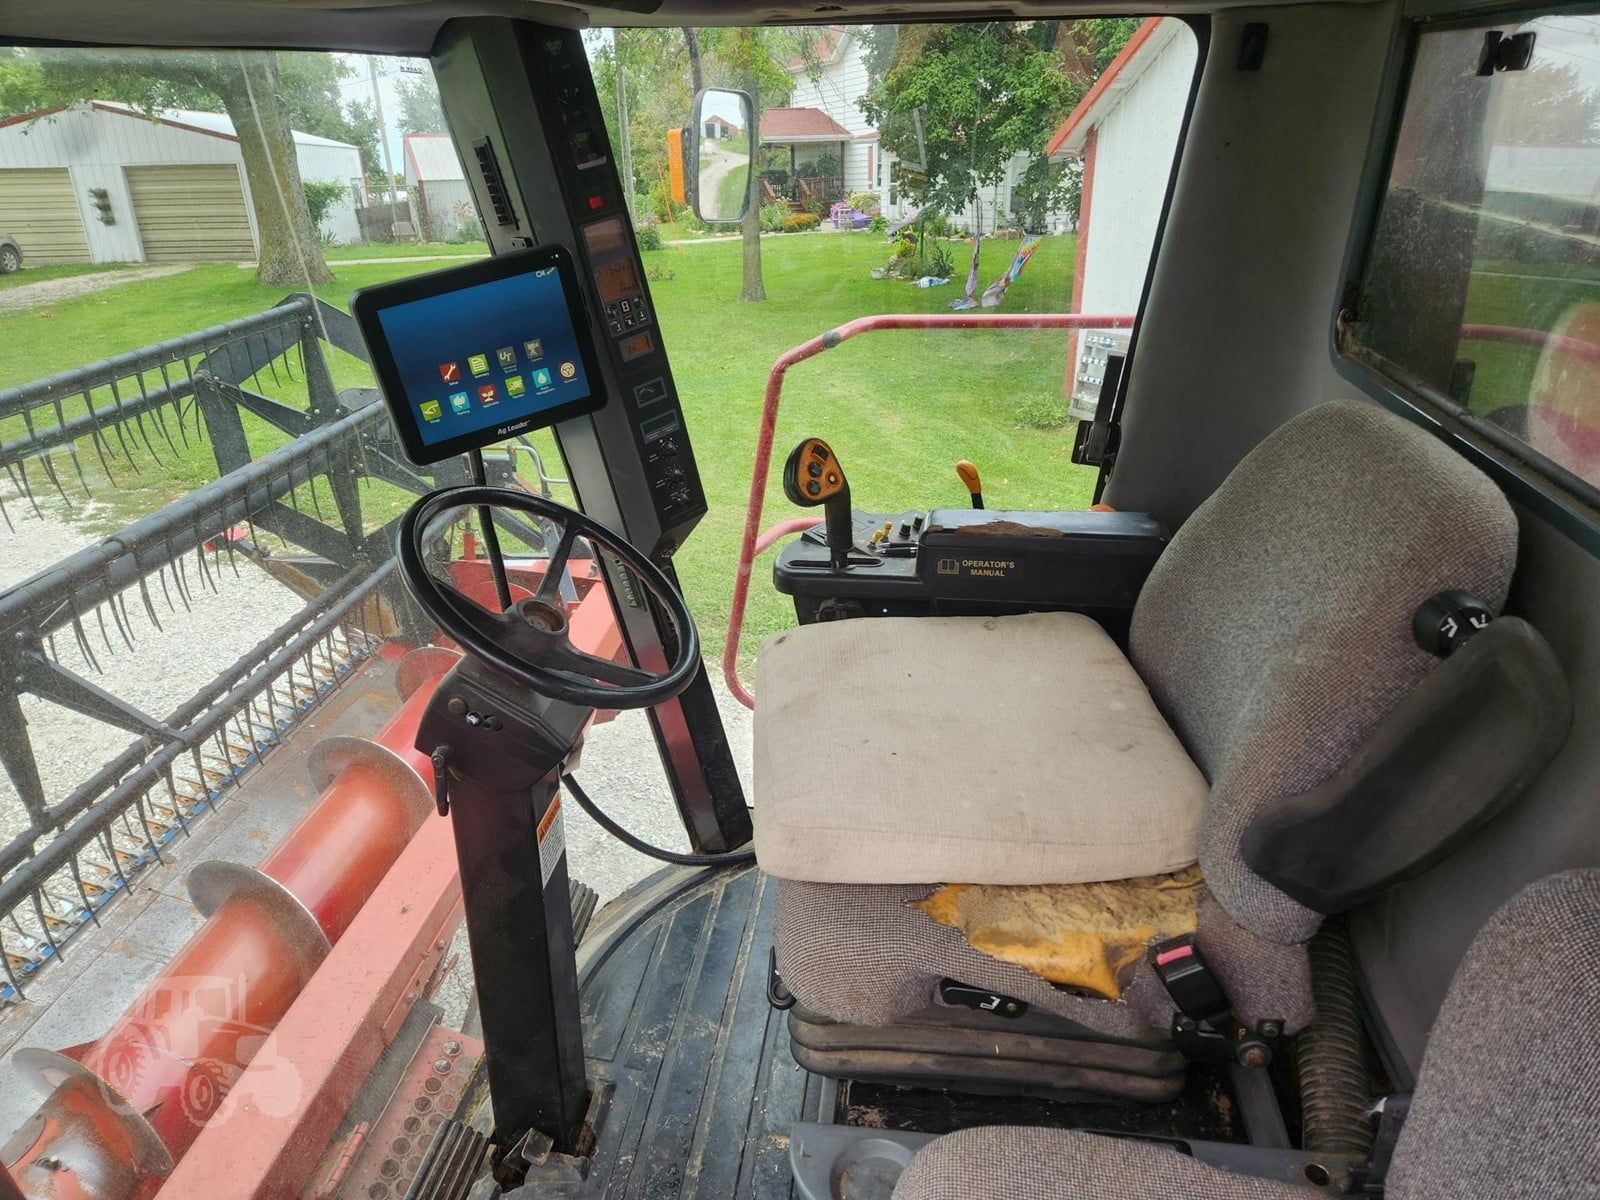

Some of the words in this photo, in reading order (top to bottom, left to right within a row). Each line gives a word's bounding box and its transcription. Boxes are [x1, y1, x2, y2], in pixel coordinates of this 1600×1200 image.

[500, 352, 511, 361] UT
[507, 420, 529, 431] Leader
[962, 560, 1015, 568] OPERATOR'S
